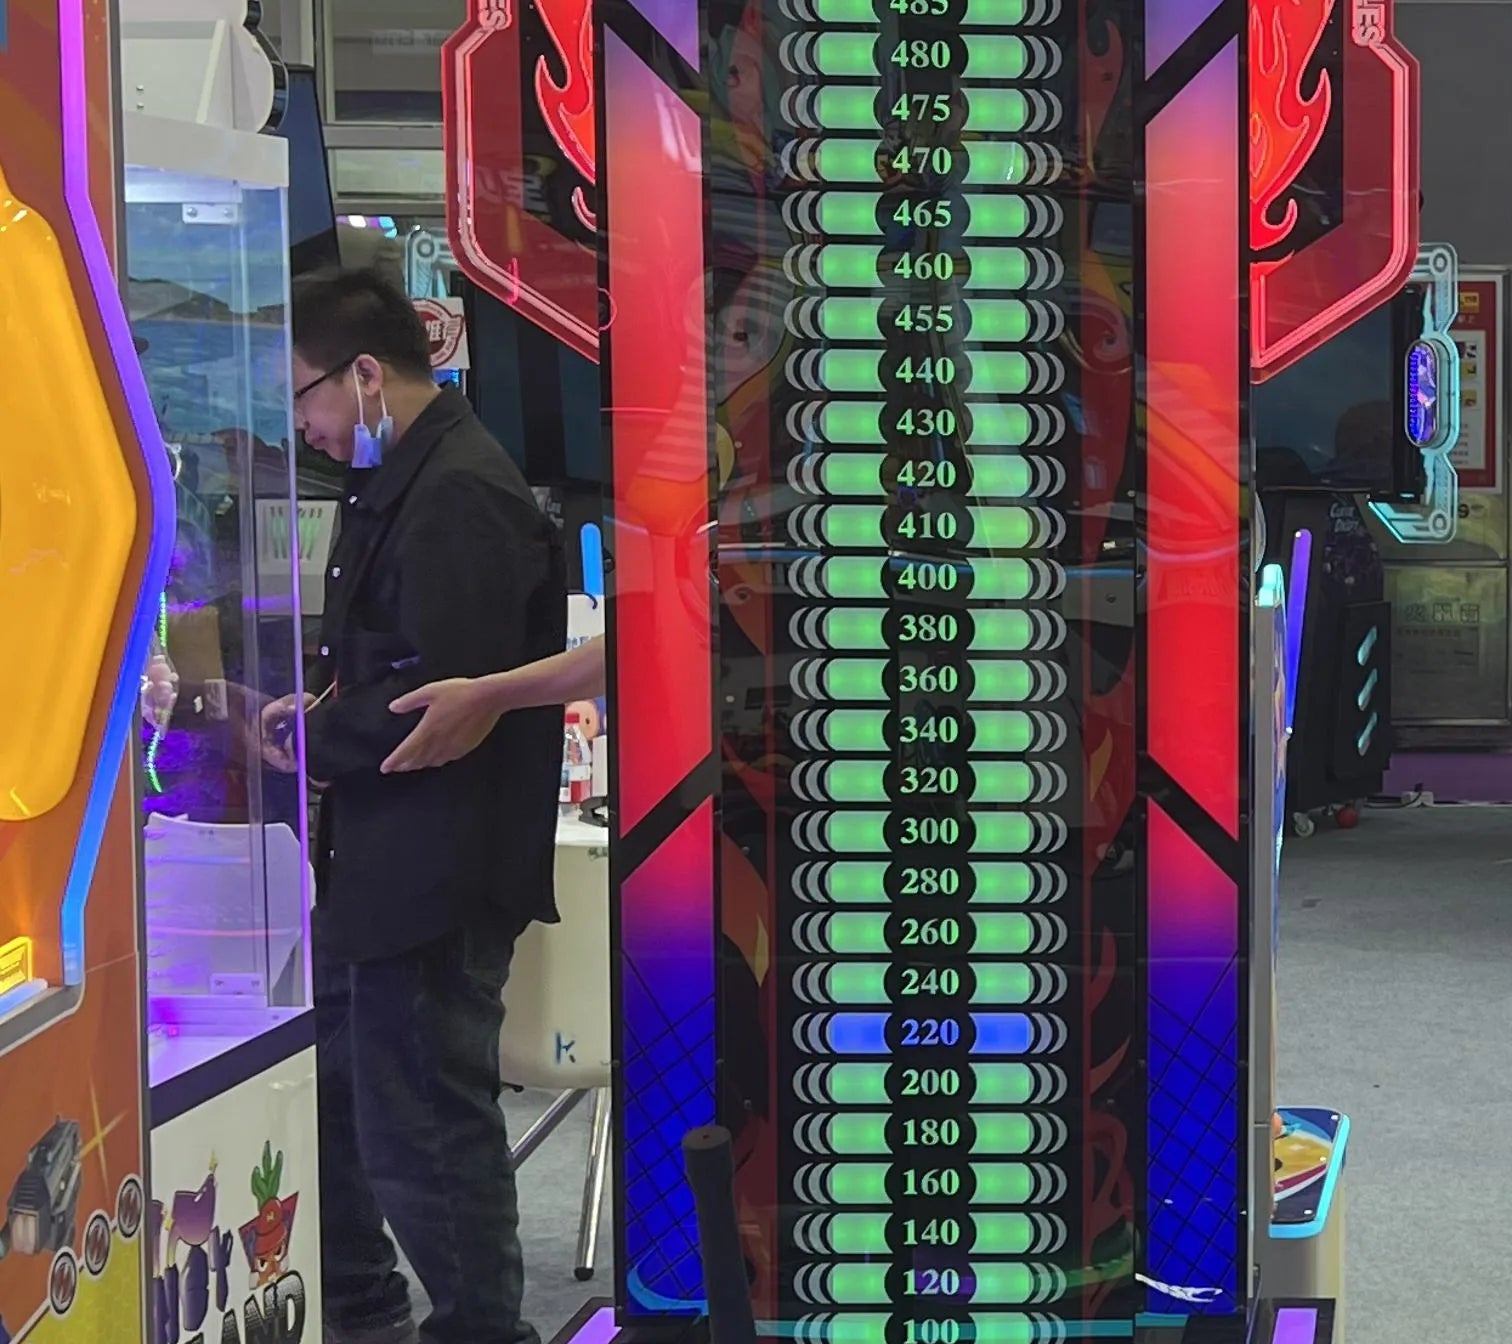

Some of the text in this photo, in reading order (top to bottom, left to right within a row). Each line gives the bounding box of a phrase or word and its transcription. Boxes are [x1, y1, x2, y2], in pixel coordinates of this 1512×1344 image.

[890, 40, 951, 69] 480
[891, 93, 951, 122] 475
[892, 146, 952, 175] 470
[893, 199, 952, 227] 465
[893, 252, 954, 281] 460
[894, 304, 953, 332] 455
[895, 356, 955, 385] 440
[896, 408, 956, 436] 430
[896, 460, 956, 488] 420
[897, 511, 957, 539] 410
[897, 562, 957, 590] 400
[898, 614, 958, 642] 380
[899, 665, 958, 693] 360
[899, 716, 959, 743] 340
[900, 766, 959, 794] 320
[900, 817, 959, 845] 300
[900, 868, 959, 895] 280
[900, 918, 959, 945] 260
[901, 968, 960, 995] 240
[900, 1018, 960, 1046] 220
[901, 1069, 960, 1096] 200
[903, 1119, 960, 1145] 180
[903, 1169, 960, 1196] 160
[903, 1219, 960, 1246] 140
[903, 1268, 960, 1296] 120
[903, 1319, 960, 1344] 100
